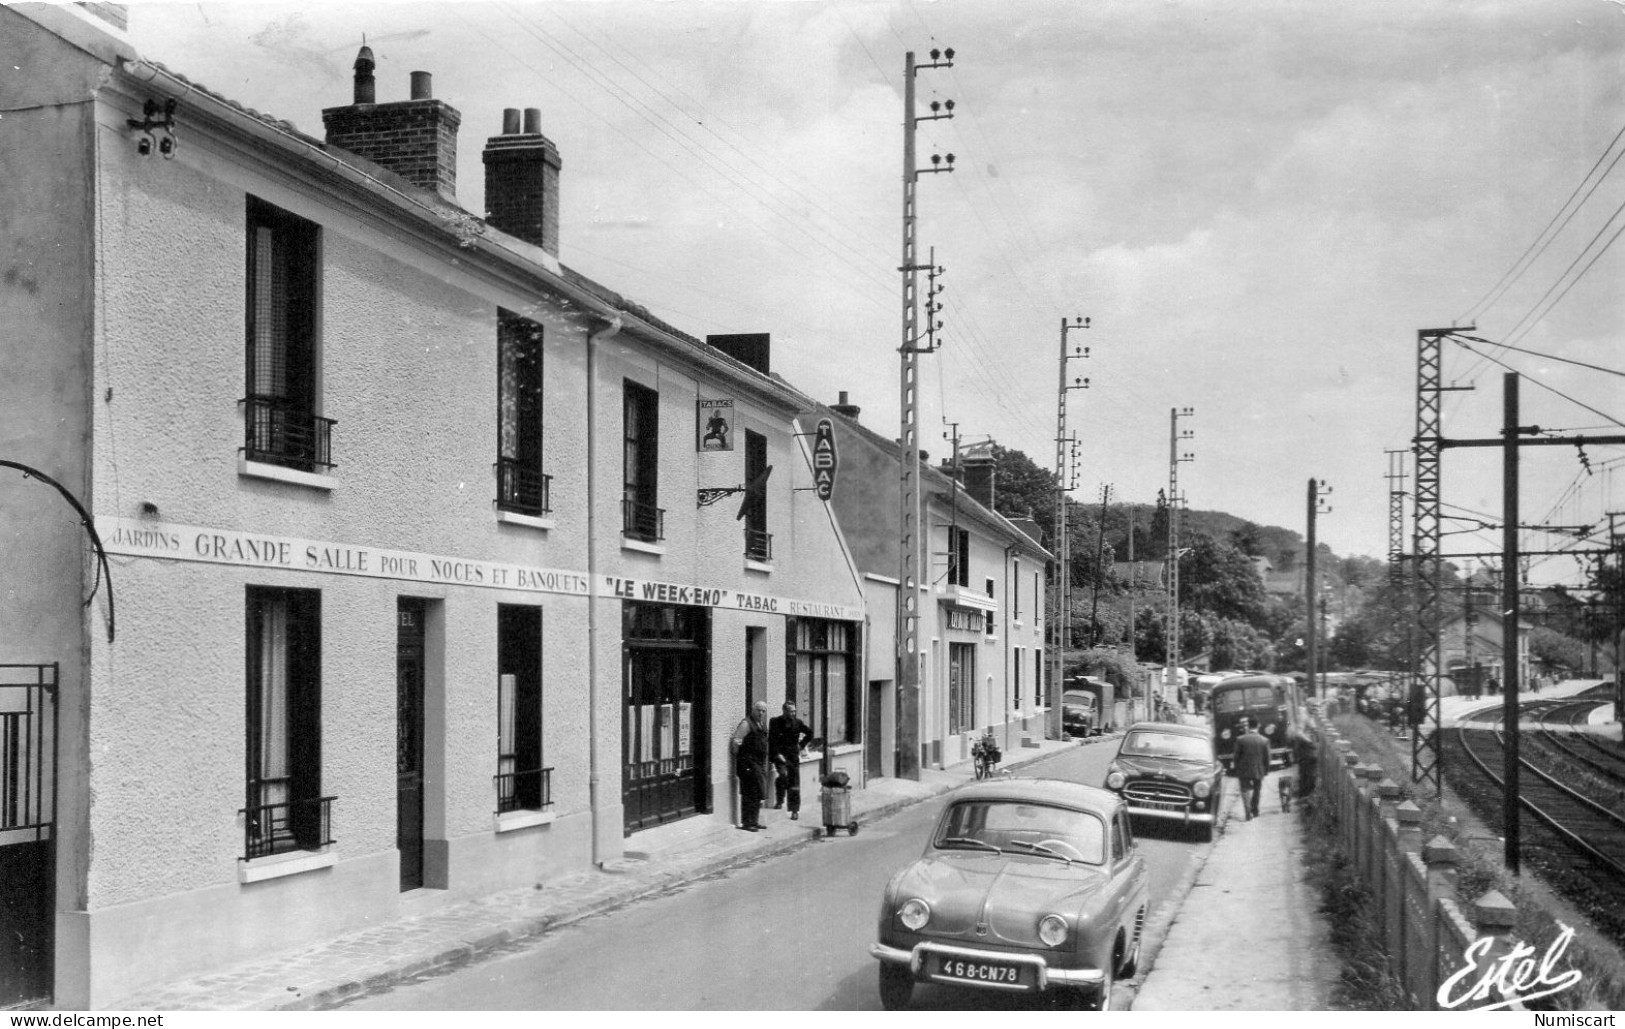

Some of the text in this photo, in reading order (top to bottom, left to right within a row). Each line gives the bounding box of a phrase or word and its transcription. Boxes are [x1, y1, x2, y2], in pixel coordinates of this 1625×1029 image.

[815, 424, 833, 495] TABAC
[113, 528, 181, 551] JARDINS
[195, 533, 291, 565] GRANDE
[306, 545, 368, 572] SALLE
[381, 556, 418, 576] POUR
[431, 559, 484, 583] NOCES
[492, 568, 508, 584] ET
[518, 569, 588, 593] BANQUETS
[736, 593, 778, 612] TABAC
[790, 601, 844, 618] RESTAURANT
[943, 960, 1017, 981] 468-CN78
